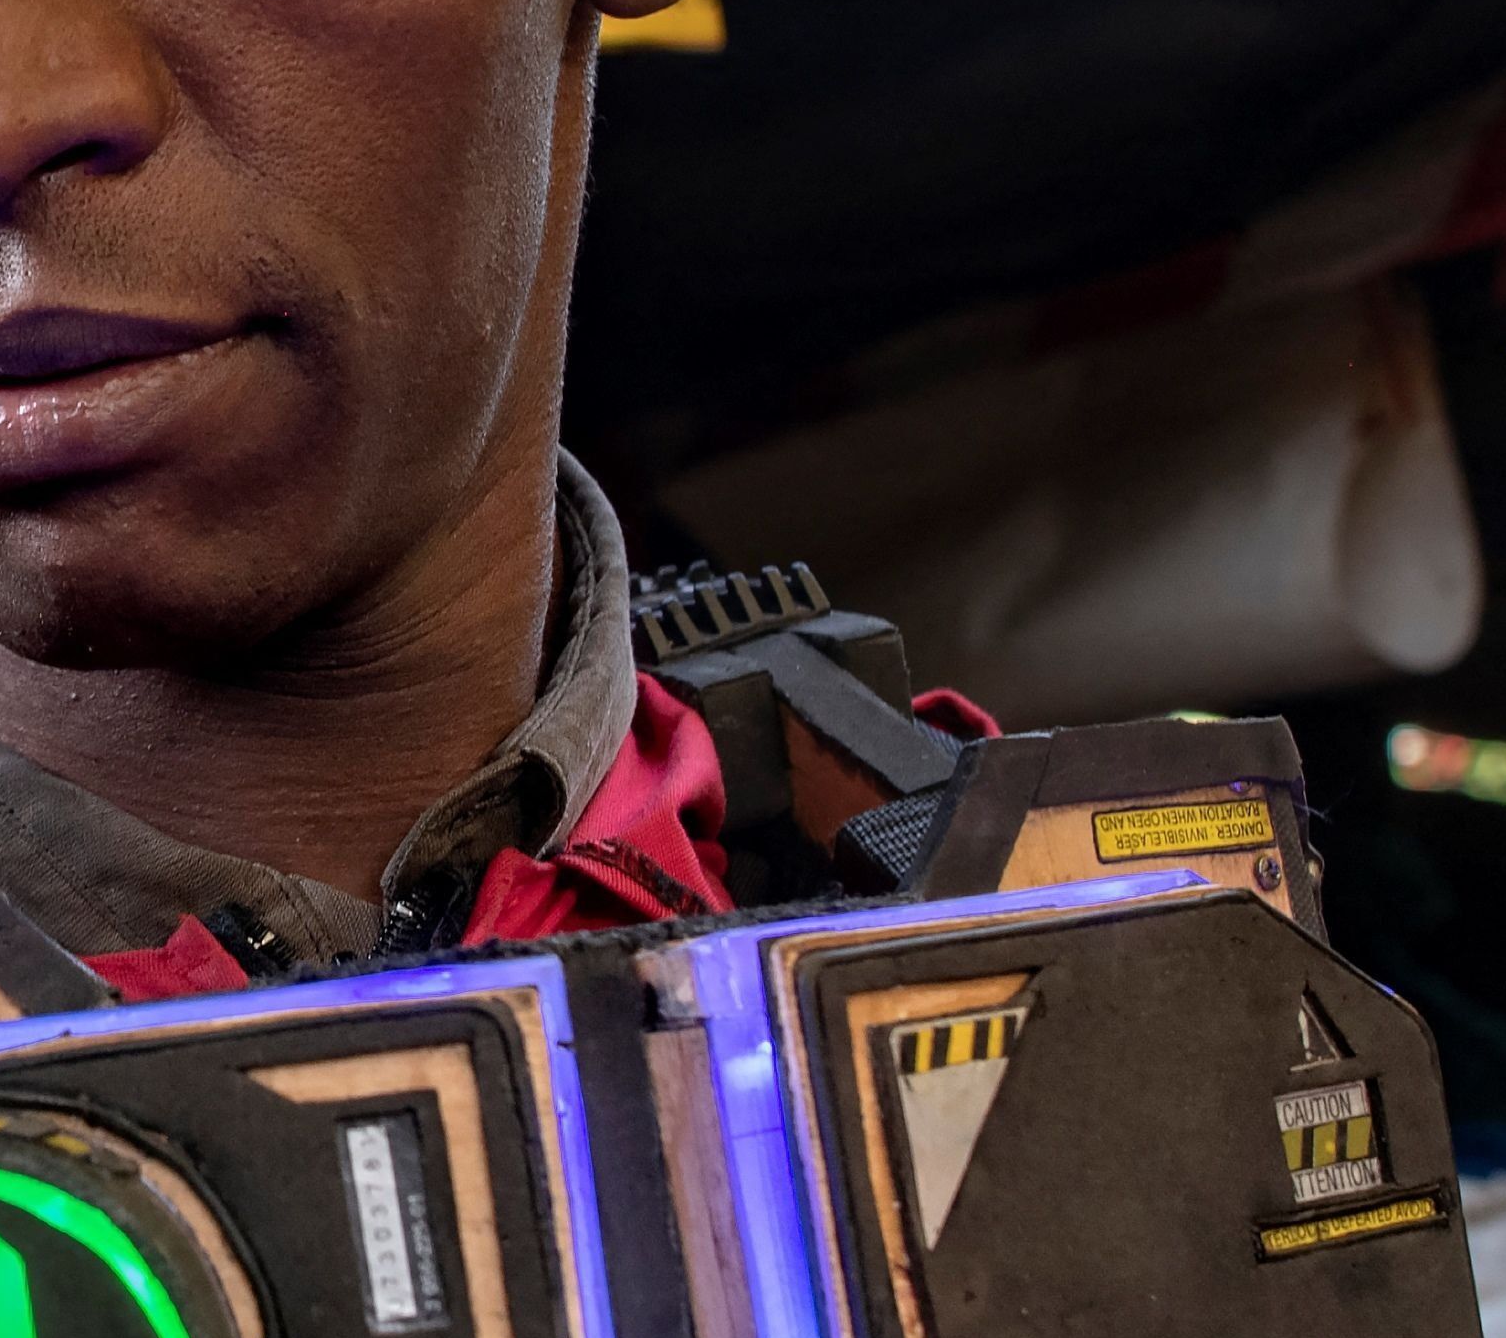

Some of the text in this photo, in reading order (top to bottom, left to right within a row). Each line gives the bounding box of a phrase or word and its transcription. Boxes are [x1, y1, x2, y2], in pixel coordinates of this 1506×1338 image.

[1099, 802, 1261, 833] RADIATION WHEN OPEN AND
[1215, 820, 1265, 840] DANGER
[1282, 1091, 1353, 1127] CAUTION
[1294, 1158, 1377, 1199] TTENTION
